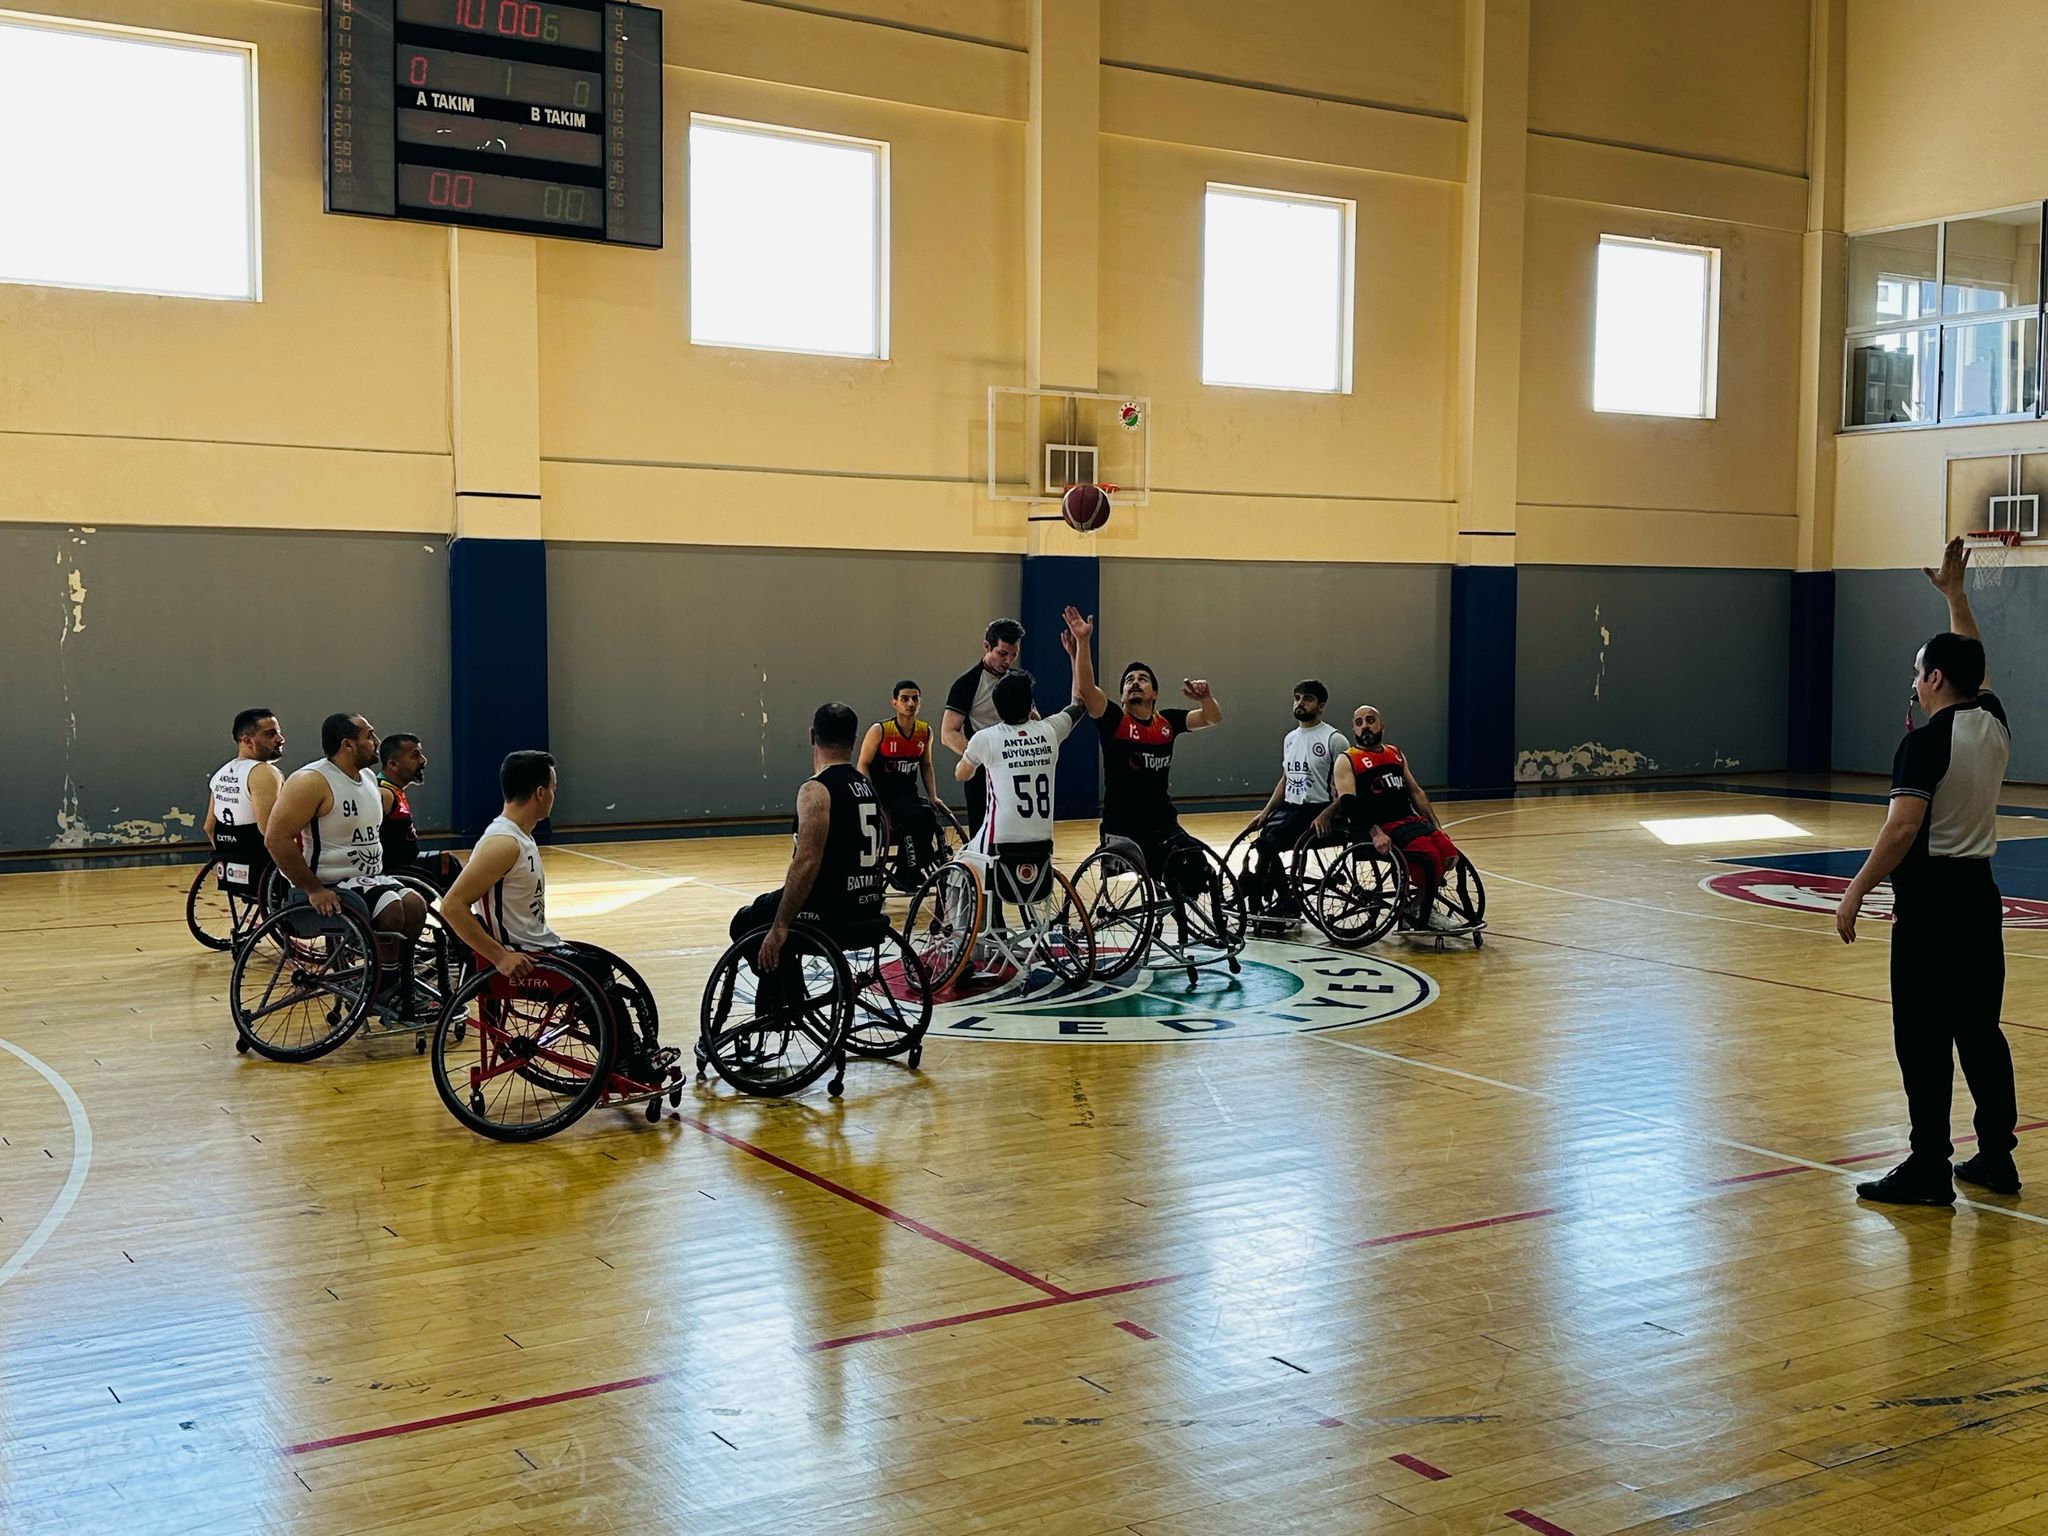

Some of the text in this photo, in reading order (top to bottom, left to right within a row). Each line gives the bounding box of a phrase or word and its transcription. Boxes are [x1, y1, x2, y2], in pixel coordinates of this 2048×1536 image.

[409, 55, 428, 86] 0
[416, 91, 475, 113] A TAKIM
[531, 106, 586, 128] B TAKIM
[428, 171, 473, 208] 00
[889, 741, 897, 753] 11
[1003, 735, 1047, 748] ANTALYA
[1001, 745, 1052, 760] BÜYÜKŞEHİR
[1008, 757, 1051, 769] BELEDİYESİ
[1361, 756, 1374, 769] 6
[1012, 773, 1051, 819] 58
[343, 799, 358, 817] 94
[216, 834, 237, 843] EXTRA
[858, 802, 877, 867] 5
[796, 911, 821, 921] XTRA
[508, 977, 550, 989] EXTRA
